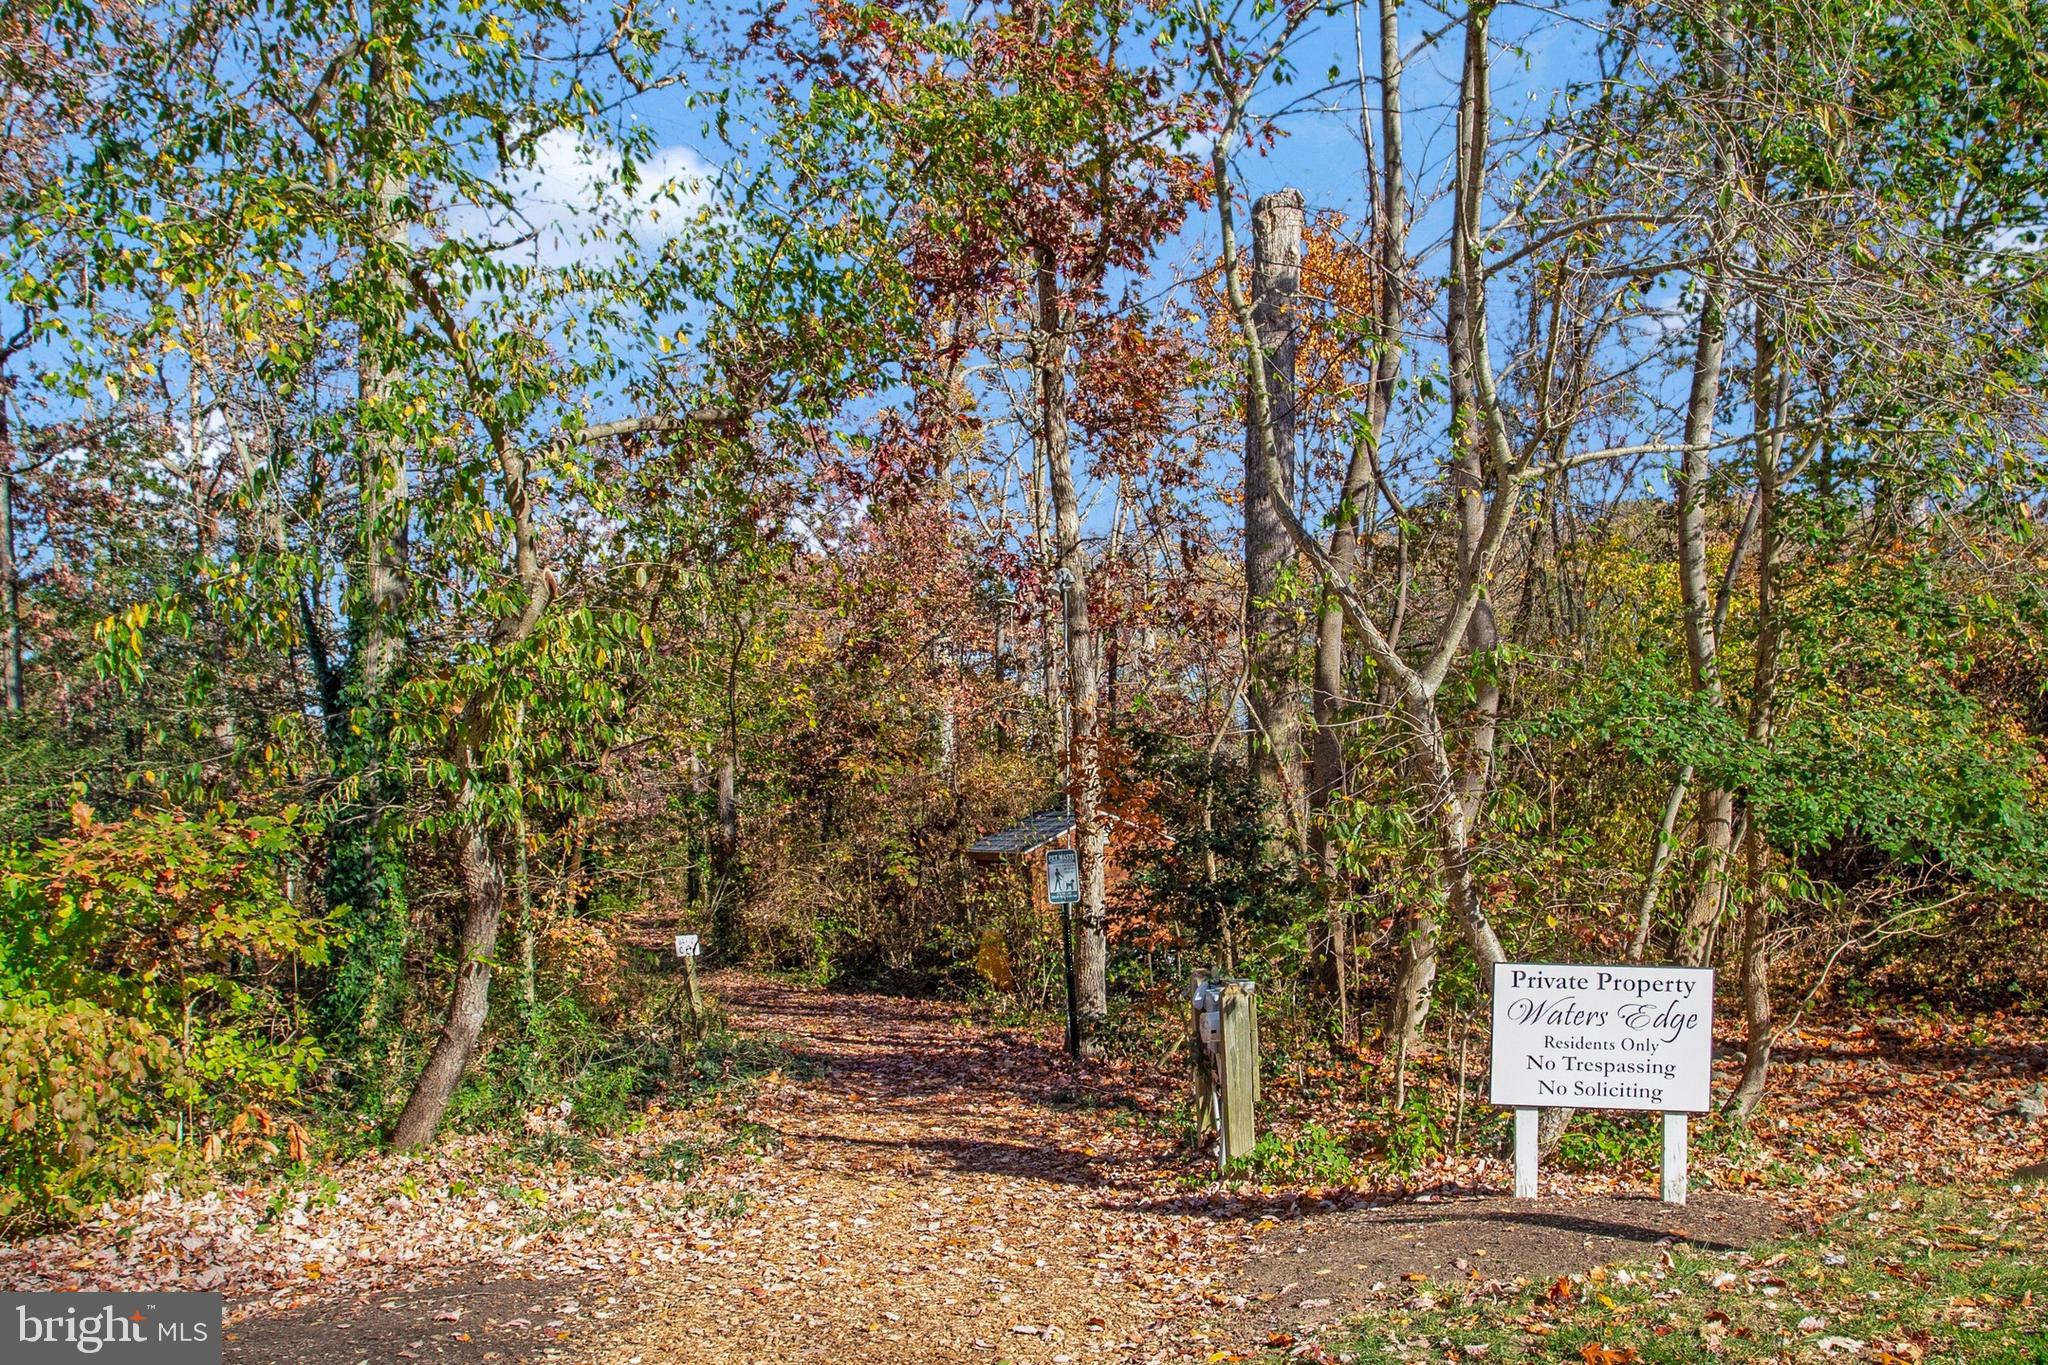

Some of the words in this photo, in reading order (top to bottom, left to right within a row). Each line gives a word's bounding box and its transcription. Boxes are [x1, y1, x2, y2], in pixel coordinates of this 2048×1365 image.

[1059, 854, 1075, 862] WASTE
[1511, 970, 1589, 990] Private
[1597, 972, 1696, 998] Property
[1507, 996, 1609, 1027] Waters
[1617, 999, 1698, 1044] Edge
[1544, 1035, 1616, 1051] Residents
[1621, 1037, 1660, 1055] Only
[1526, 1055, 1556, 1071] No
[1561, 1056, 1677, 1080] Trespassing
[1538, 1080, 1567, 1096] No
[1574, 1080, 1664, 1104] Soliciting
